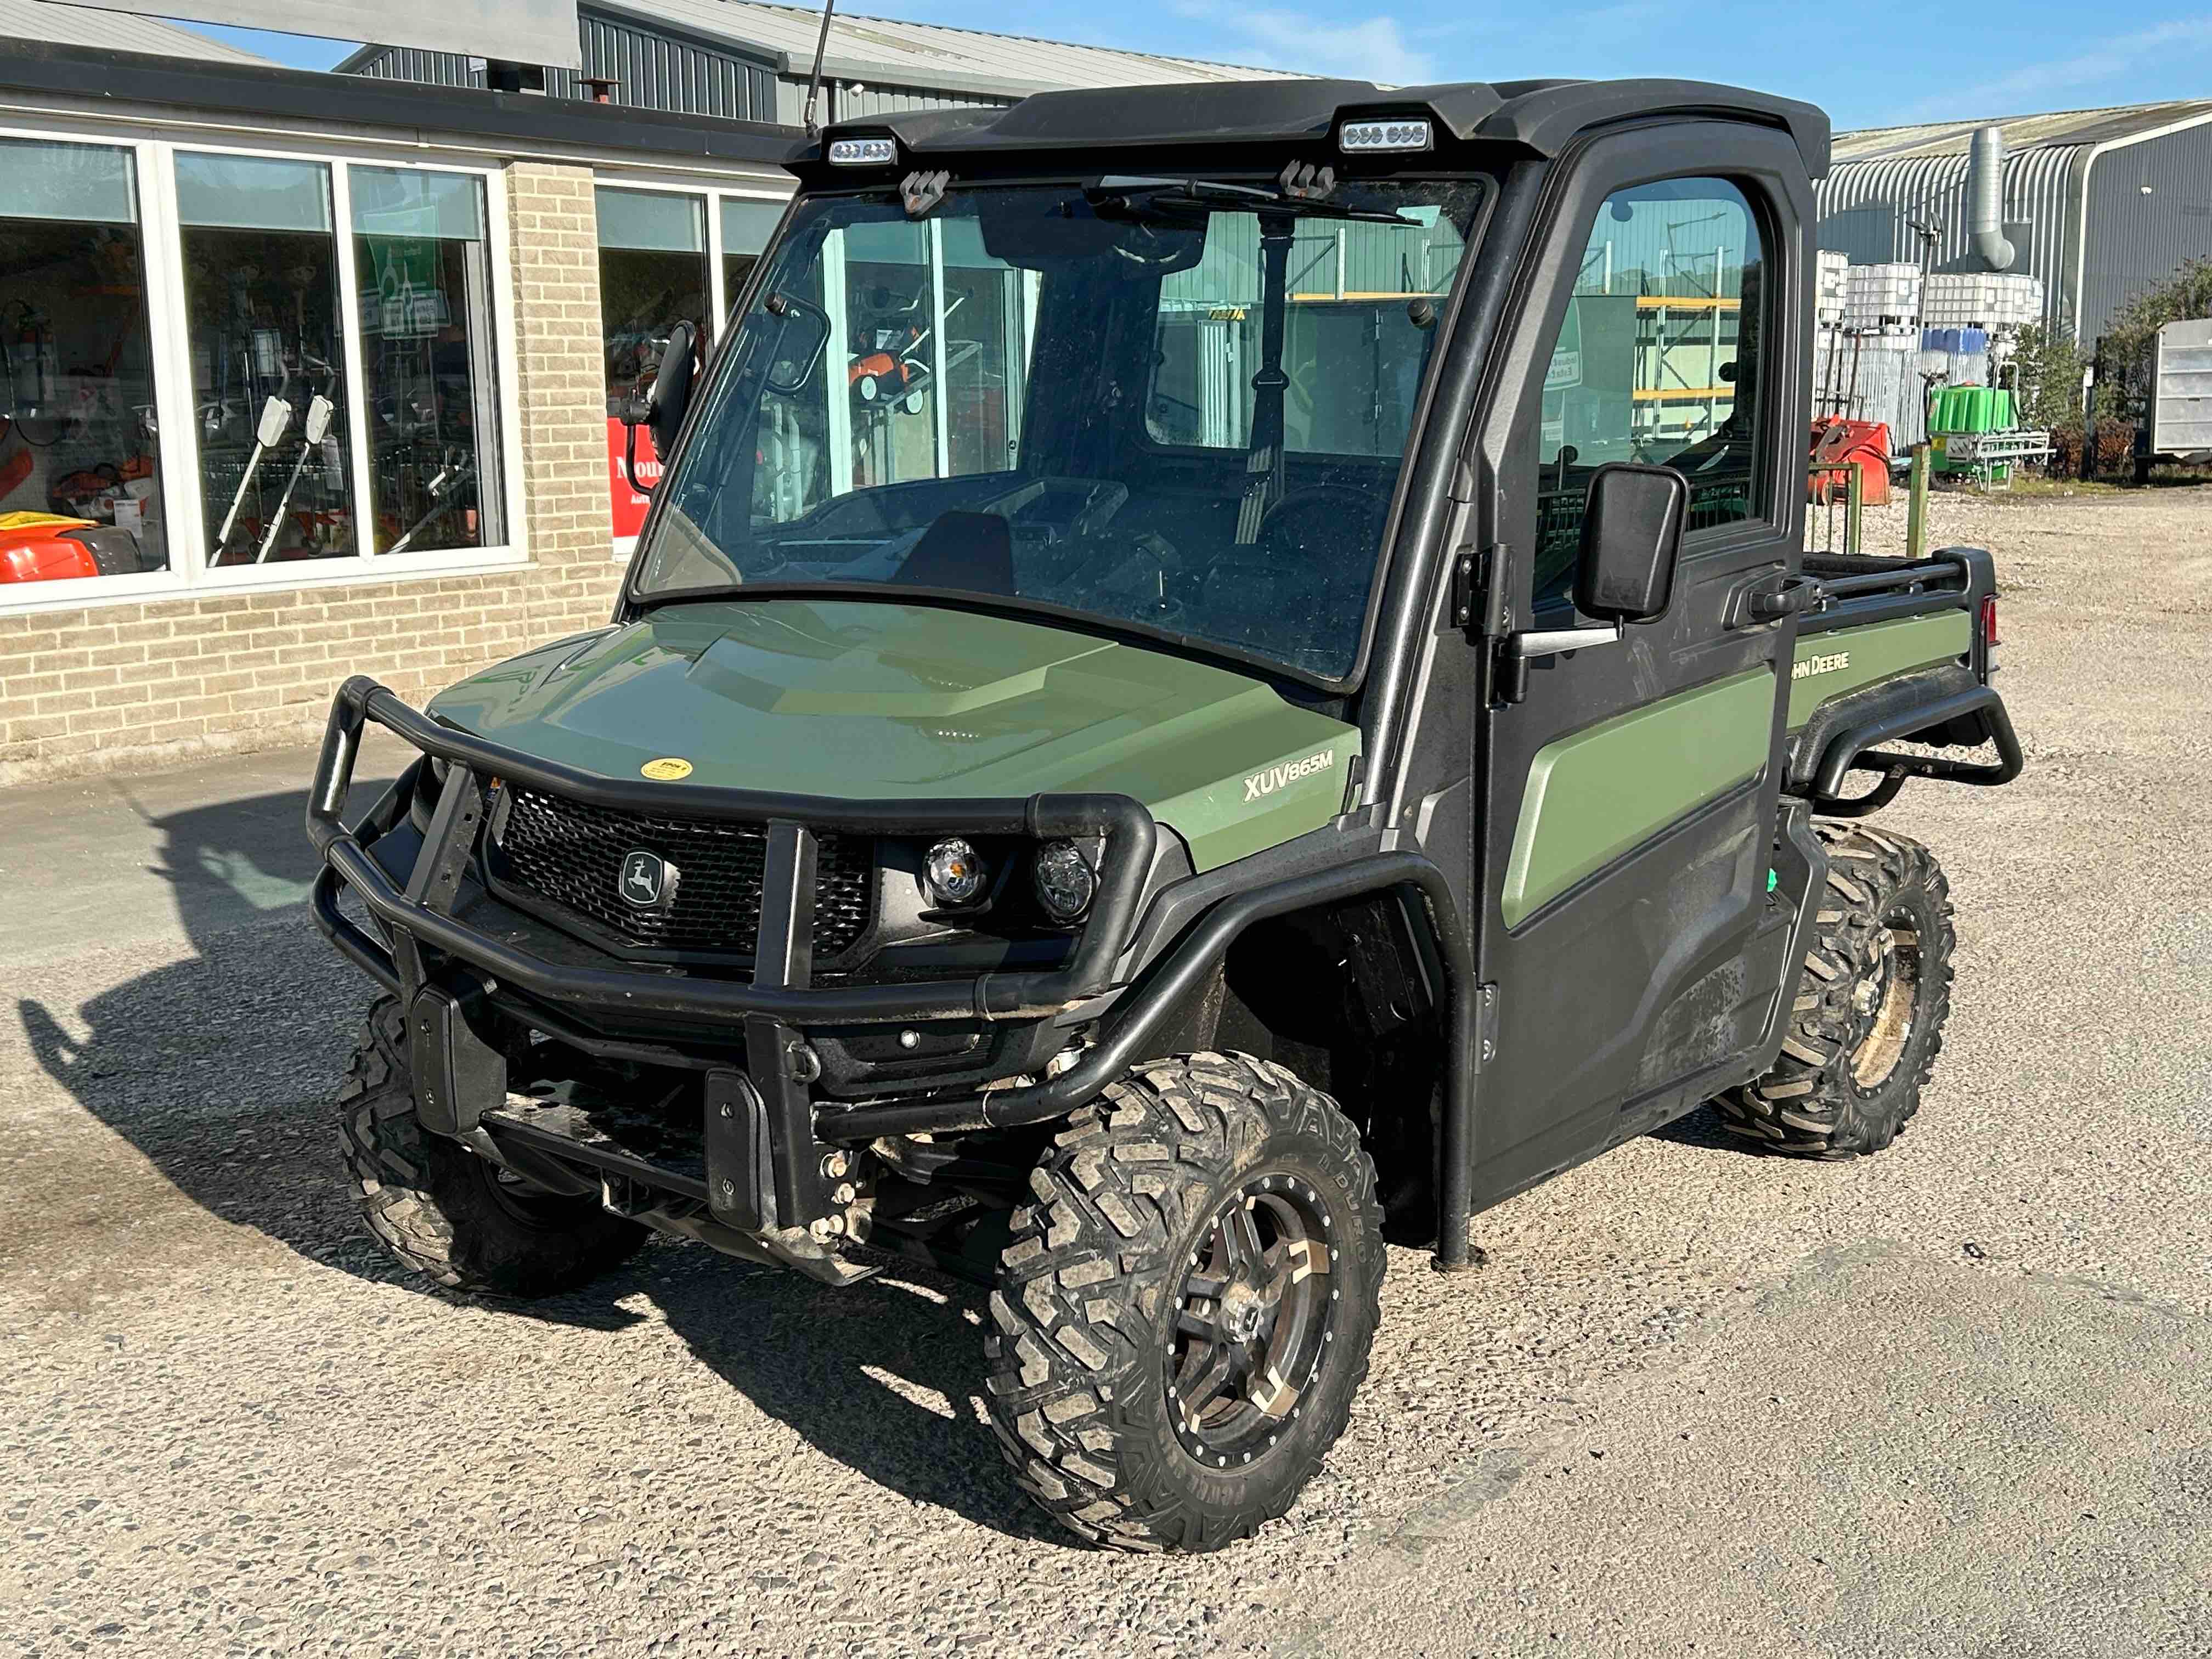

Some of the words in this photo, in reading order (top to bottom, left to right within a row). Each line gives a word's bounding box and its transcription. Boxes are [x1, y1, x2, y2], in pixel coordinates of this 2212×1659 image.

[1791, 661, 1810, 680] HN
[1811, 653, 1849, 676] DEERE
[1243, 749, 1333, 803] XUV865M
